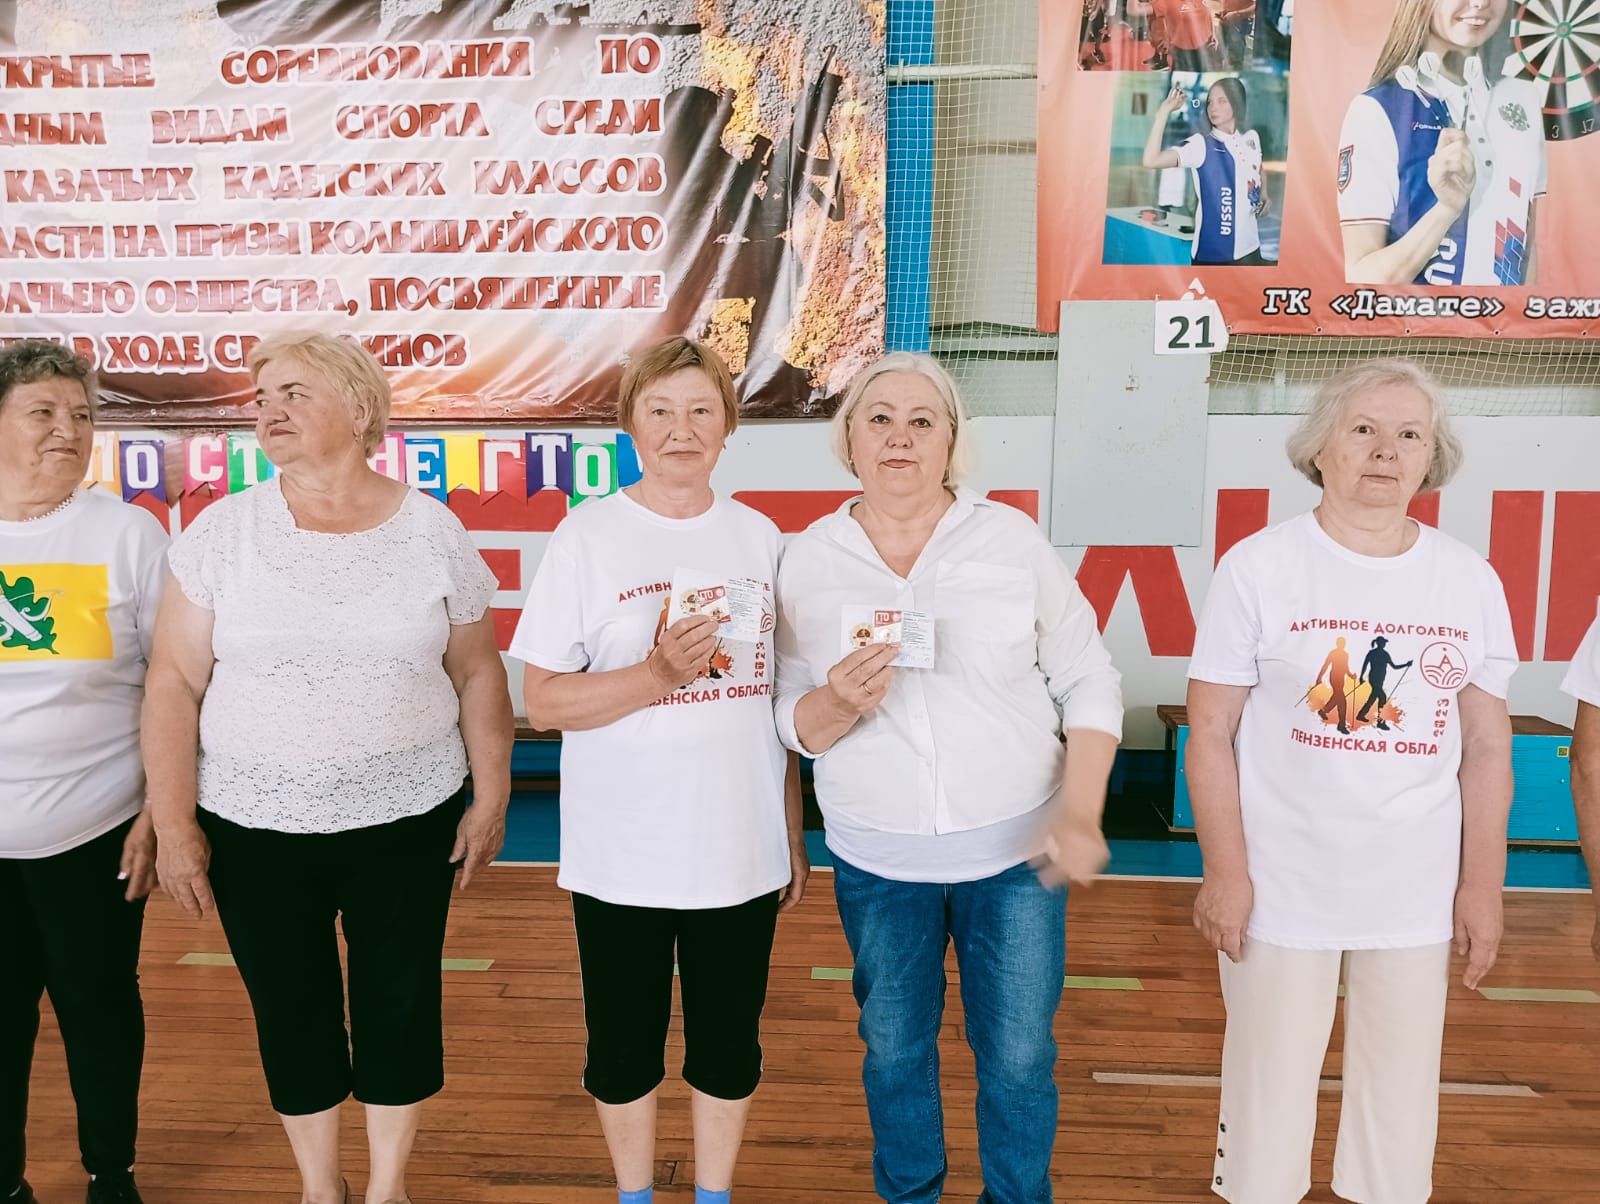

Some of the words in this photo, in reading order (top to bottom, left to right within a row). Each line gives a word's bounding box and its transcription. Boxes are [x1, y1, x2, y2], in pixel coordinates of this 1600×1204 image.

[221, 42, 531, 85] СОРЕВНОВАНИЯ
[601, 37, 661, 74] ПО
[152, 108, 290, 144] ВИДАМ
[336, 102, 490, 139] СПОРТА
[535, 98, 661, 136] СРЕДИ
[5, 167, 195, 203] КАЗАЧЬИХ
[223, 164, 447, 201] КАДЕТСКИХ
[474, 157, 663, 195] КЛАССОВ
[1220, 186, 1233, 236] RUSSIA
[113, 225, 168, 258] НА
[175, 222, 302, 257] ПРИЗЫ
[310, 210, 664, 255] КОЛЫШЛЕЙСКОГО
[0, 280, 135, 313] АЧЬЕГО
[146, 279, 358, 316] ОБЩЕСТВА,
[1262, 289, 1311, 314] ГК
[1330, 288, 1505, 320] «Дамате»
[1168, 315, 1215, 349] 21
[106, 335, 205, 369] ХОДЕ
[483, 434, 643, 496] ГТО
[619, 581, 672, 602] АКТИВН
[1290, 618, 1369, 632] АКТИВНОЕ
[1374, 623, 1469, 641] ДОЛГОЛЕТИЕ
[1291, 728, 1387, 753] ПЕНЗЕНСКАЯ
